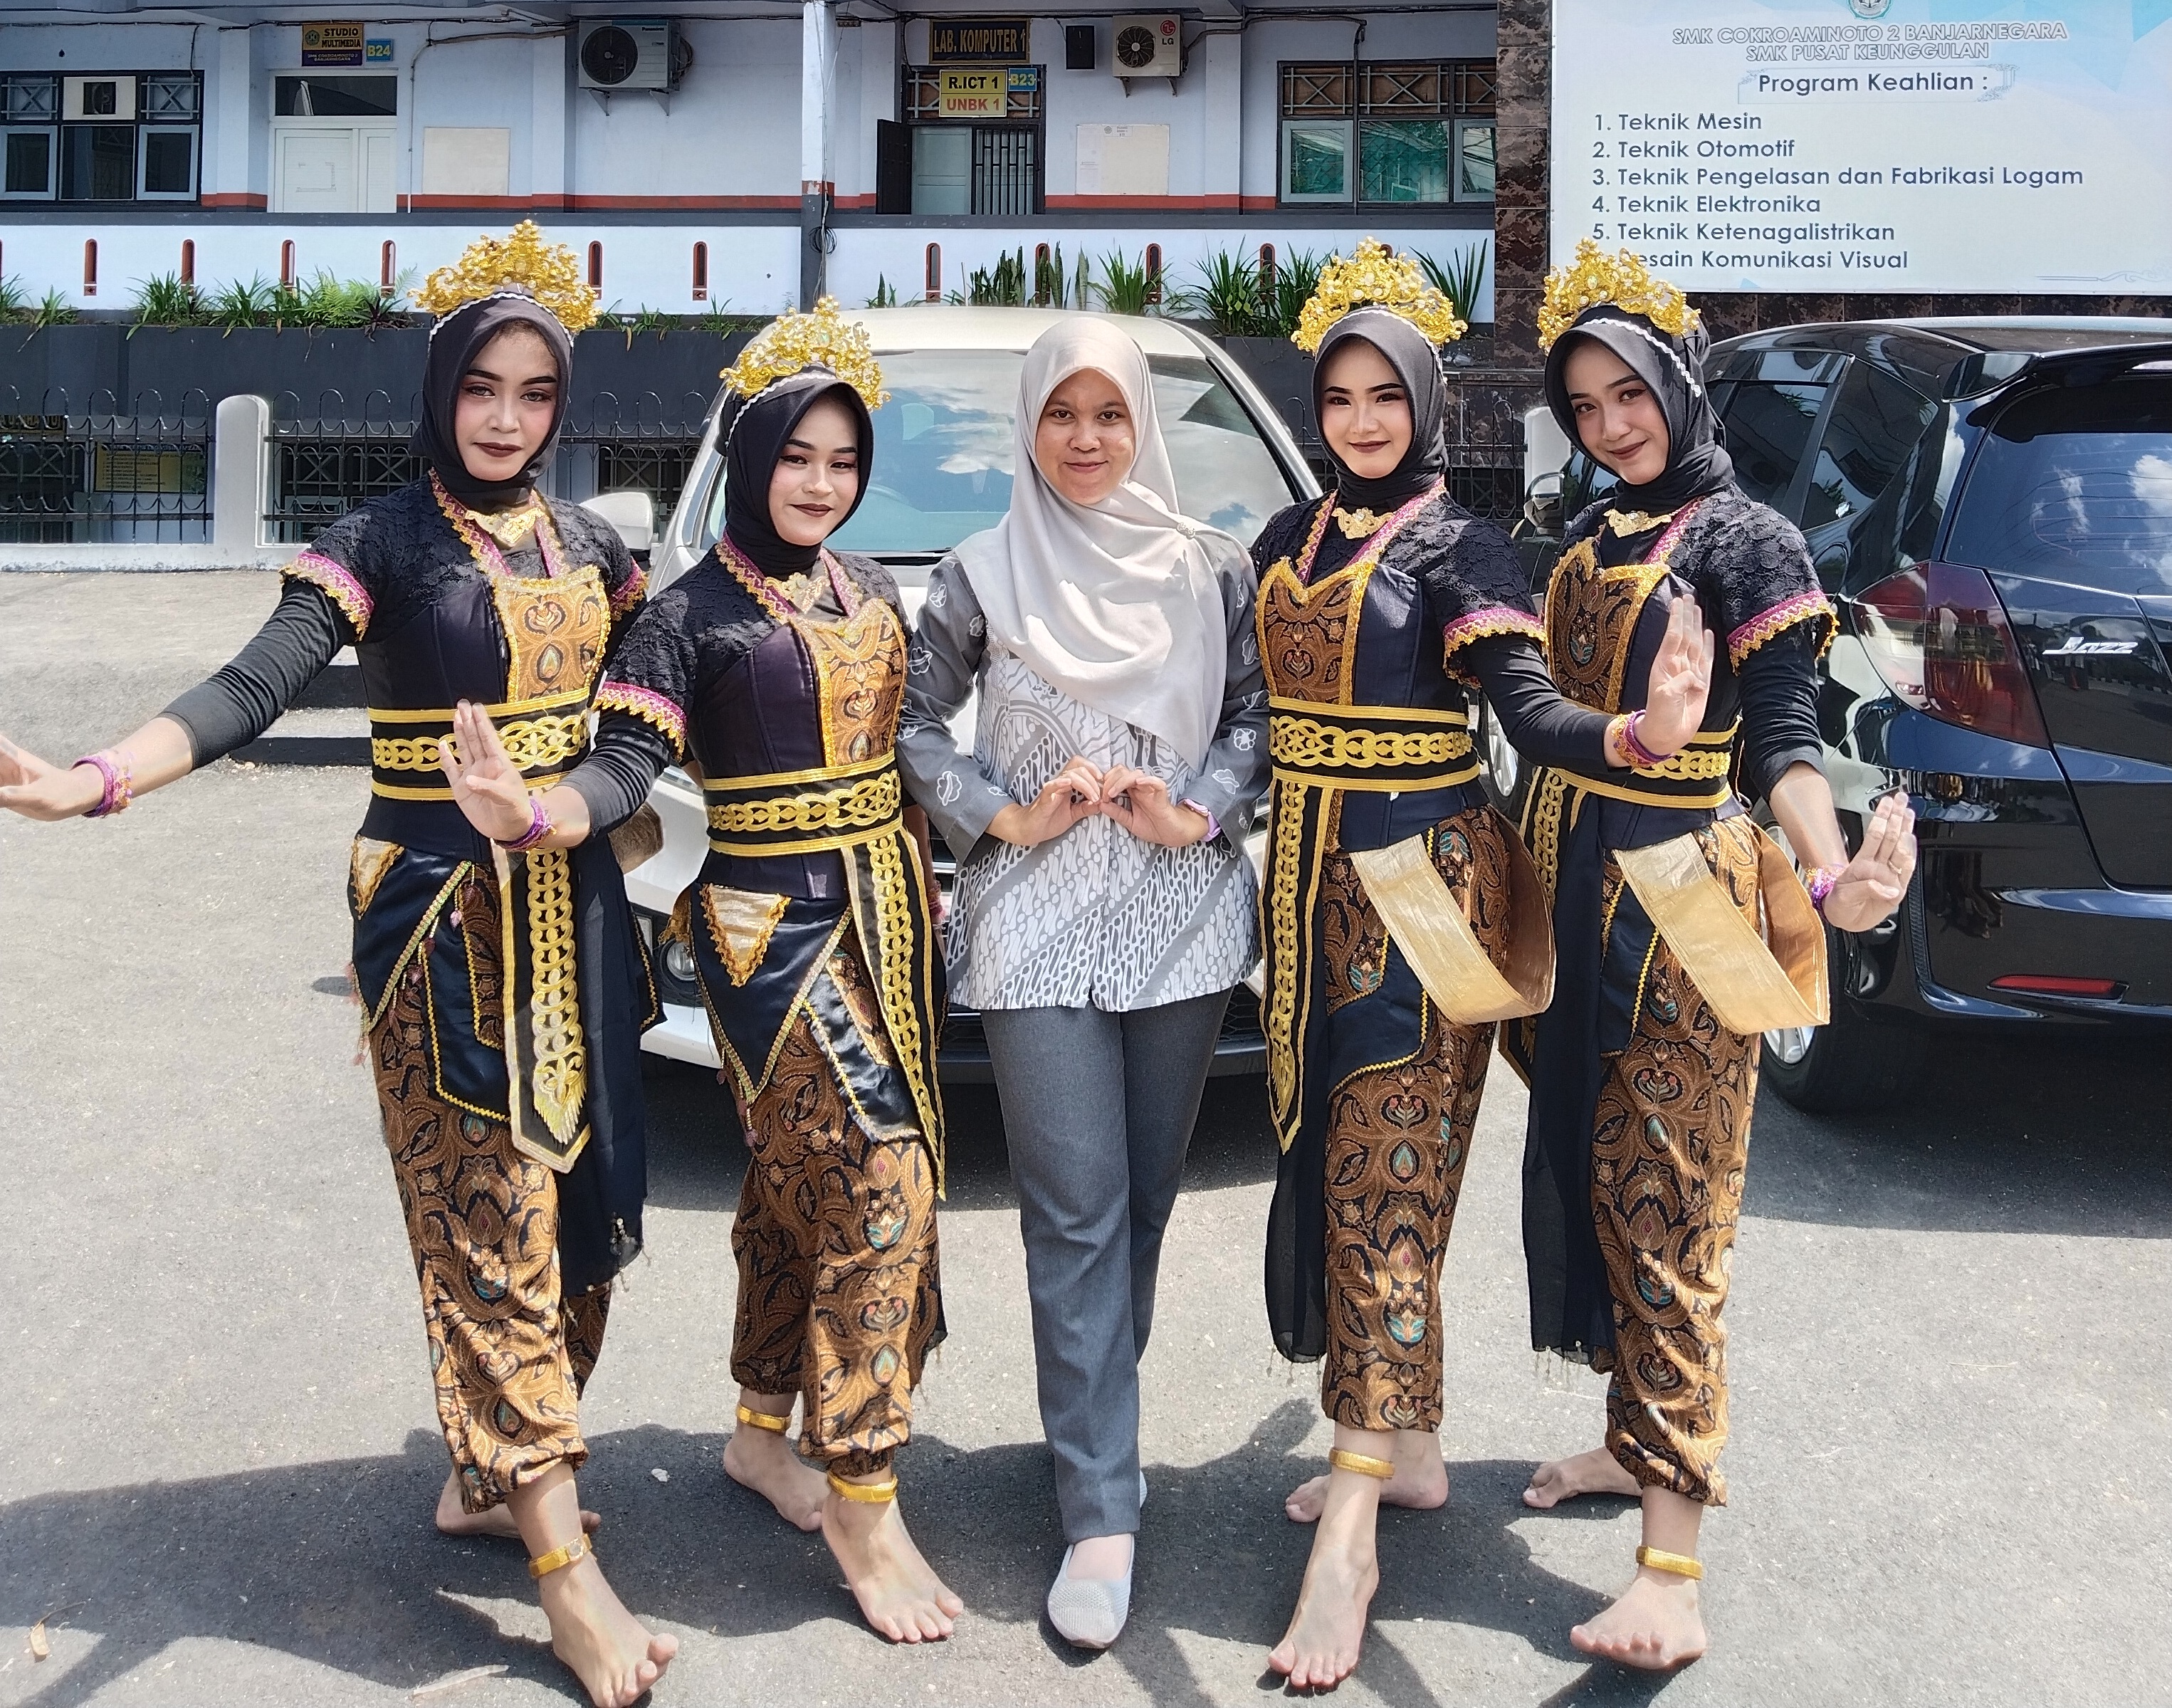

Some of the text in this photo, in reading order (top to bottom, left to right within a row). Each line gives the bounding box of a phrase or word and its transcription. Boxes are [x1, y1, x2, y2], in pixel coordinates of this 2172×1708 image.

[324, 28, 359, 36] STUDIO
[934, 28, 1026, 53] LAB. KOMPUTER 1
[1672, 23, 2067, 44] SMK COKROAMINOTO 2 BANJARNEGARA
[321, 39, 361, 48] MULTIMEDIA
[367, 45, 392, 57] B24
[1746, 43, 1989, 62] SMK PUSAT KEUNGGULAN
[991, 76, 998, 89] 1
[1010, 73, 1036, 86] B23
[1759, 75, 1859, 96] Program
[1868, 73, 1973, 90] Keahlian
[947, 98, 1000, 111] UNBK 1
[1595, 112, 1762, 130] 1. Teknik Mesin
[1593, 140, 1795, 157] 2. Teknik Otomotif
[1593, 167, 2083, 189] 3. Teknik Pengelasan dan Fabrikasi Logam
[1593, 194, 1820, 212] 4. Teknik Elektronika
[1593, 222, 1894, 243] 5. Teknik Ketenagalistrikan
[1702, 250, 1832, 268] Komunikasi
[1840, 249, 1908, 268] Visual
[2042, 636, 2139, 655] Jazz
